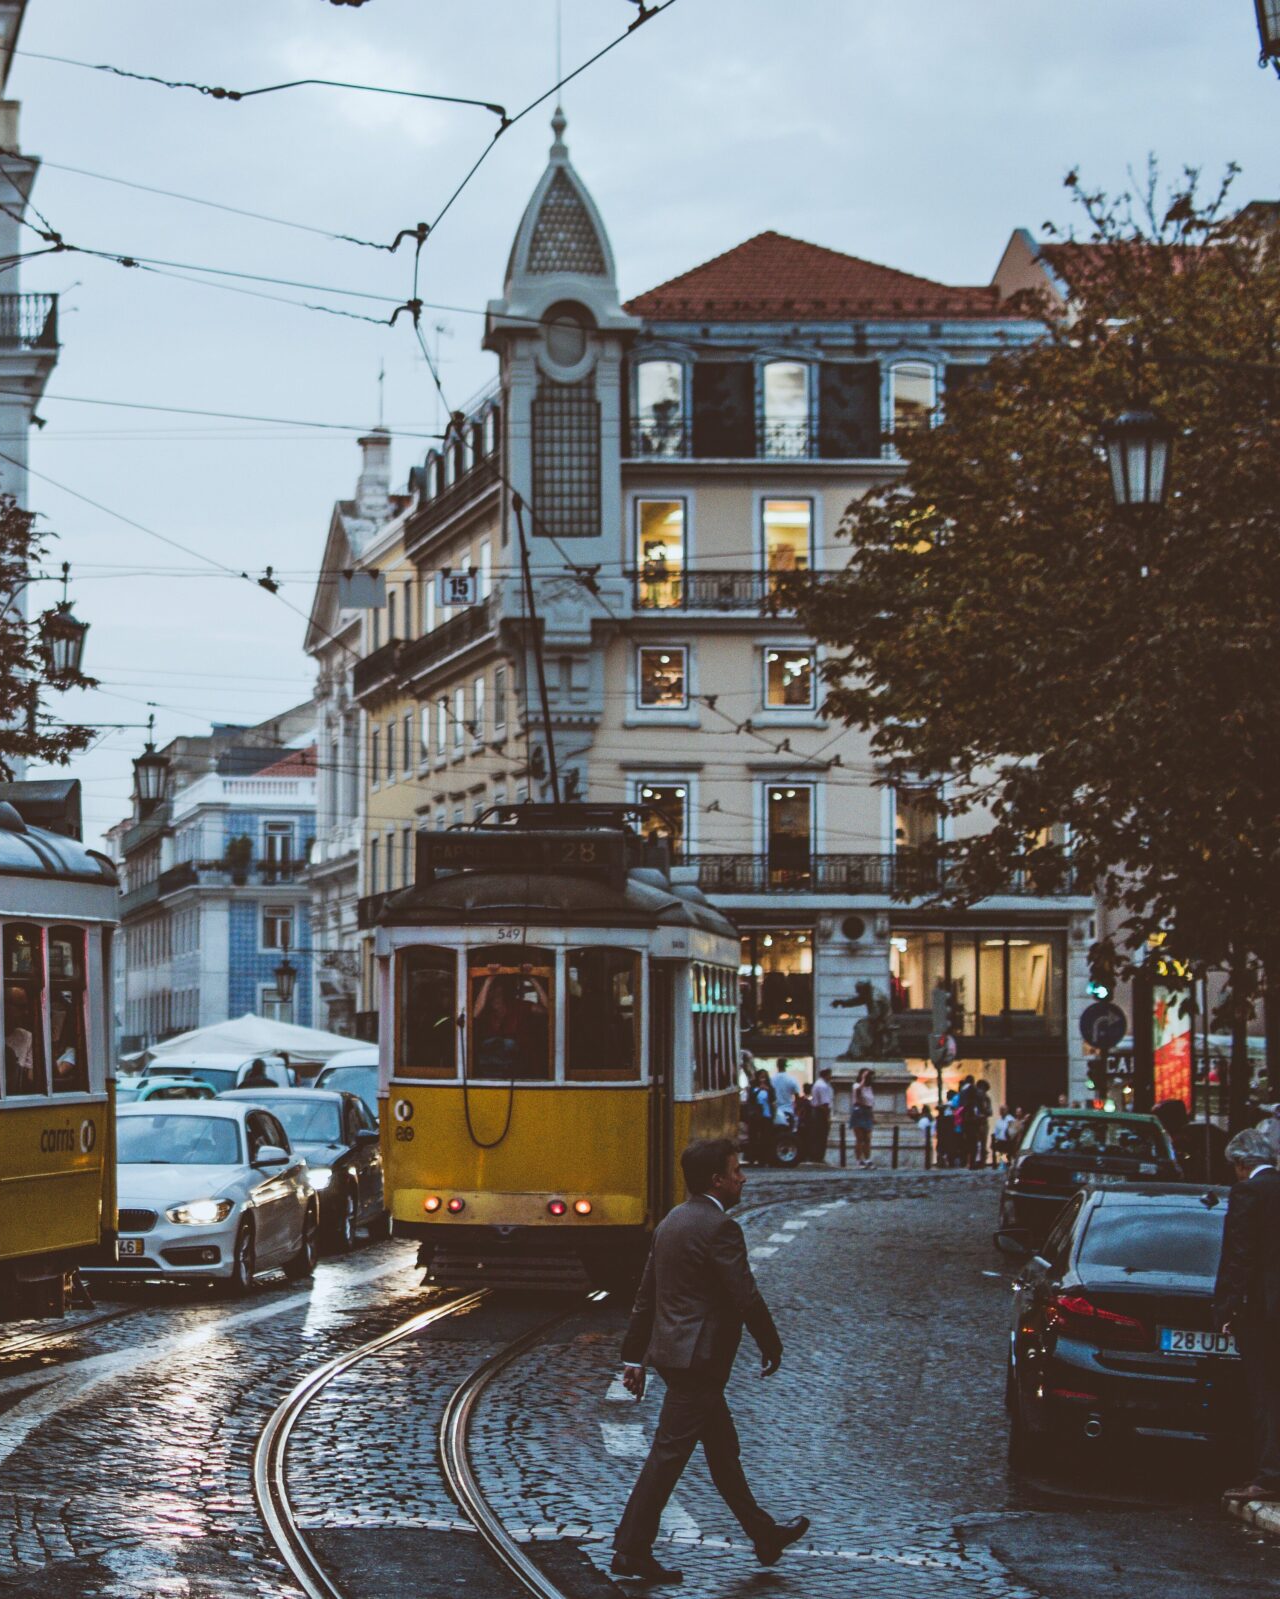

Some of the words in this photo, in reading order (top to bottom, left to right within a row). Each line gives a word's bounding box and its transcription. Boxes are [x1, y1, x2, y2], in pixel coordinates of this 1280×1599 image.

[449, 578, 468, 595] 15
[561, 842, 596, 863] 28
[497, 928, 521, 941] 549
[40, 1119, 75, 1152] carris
